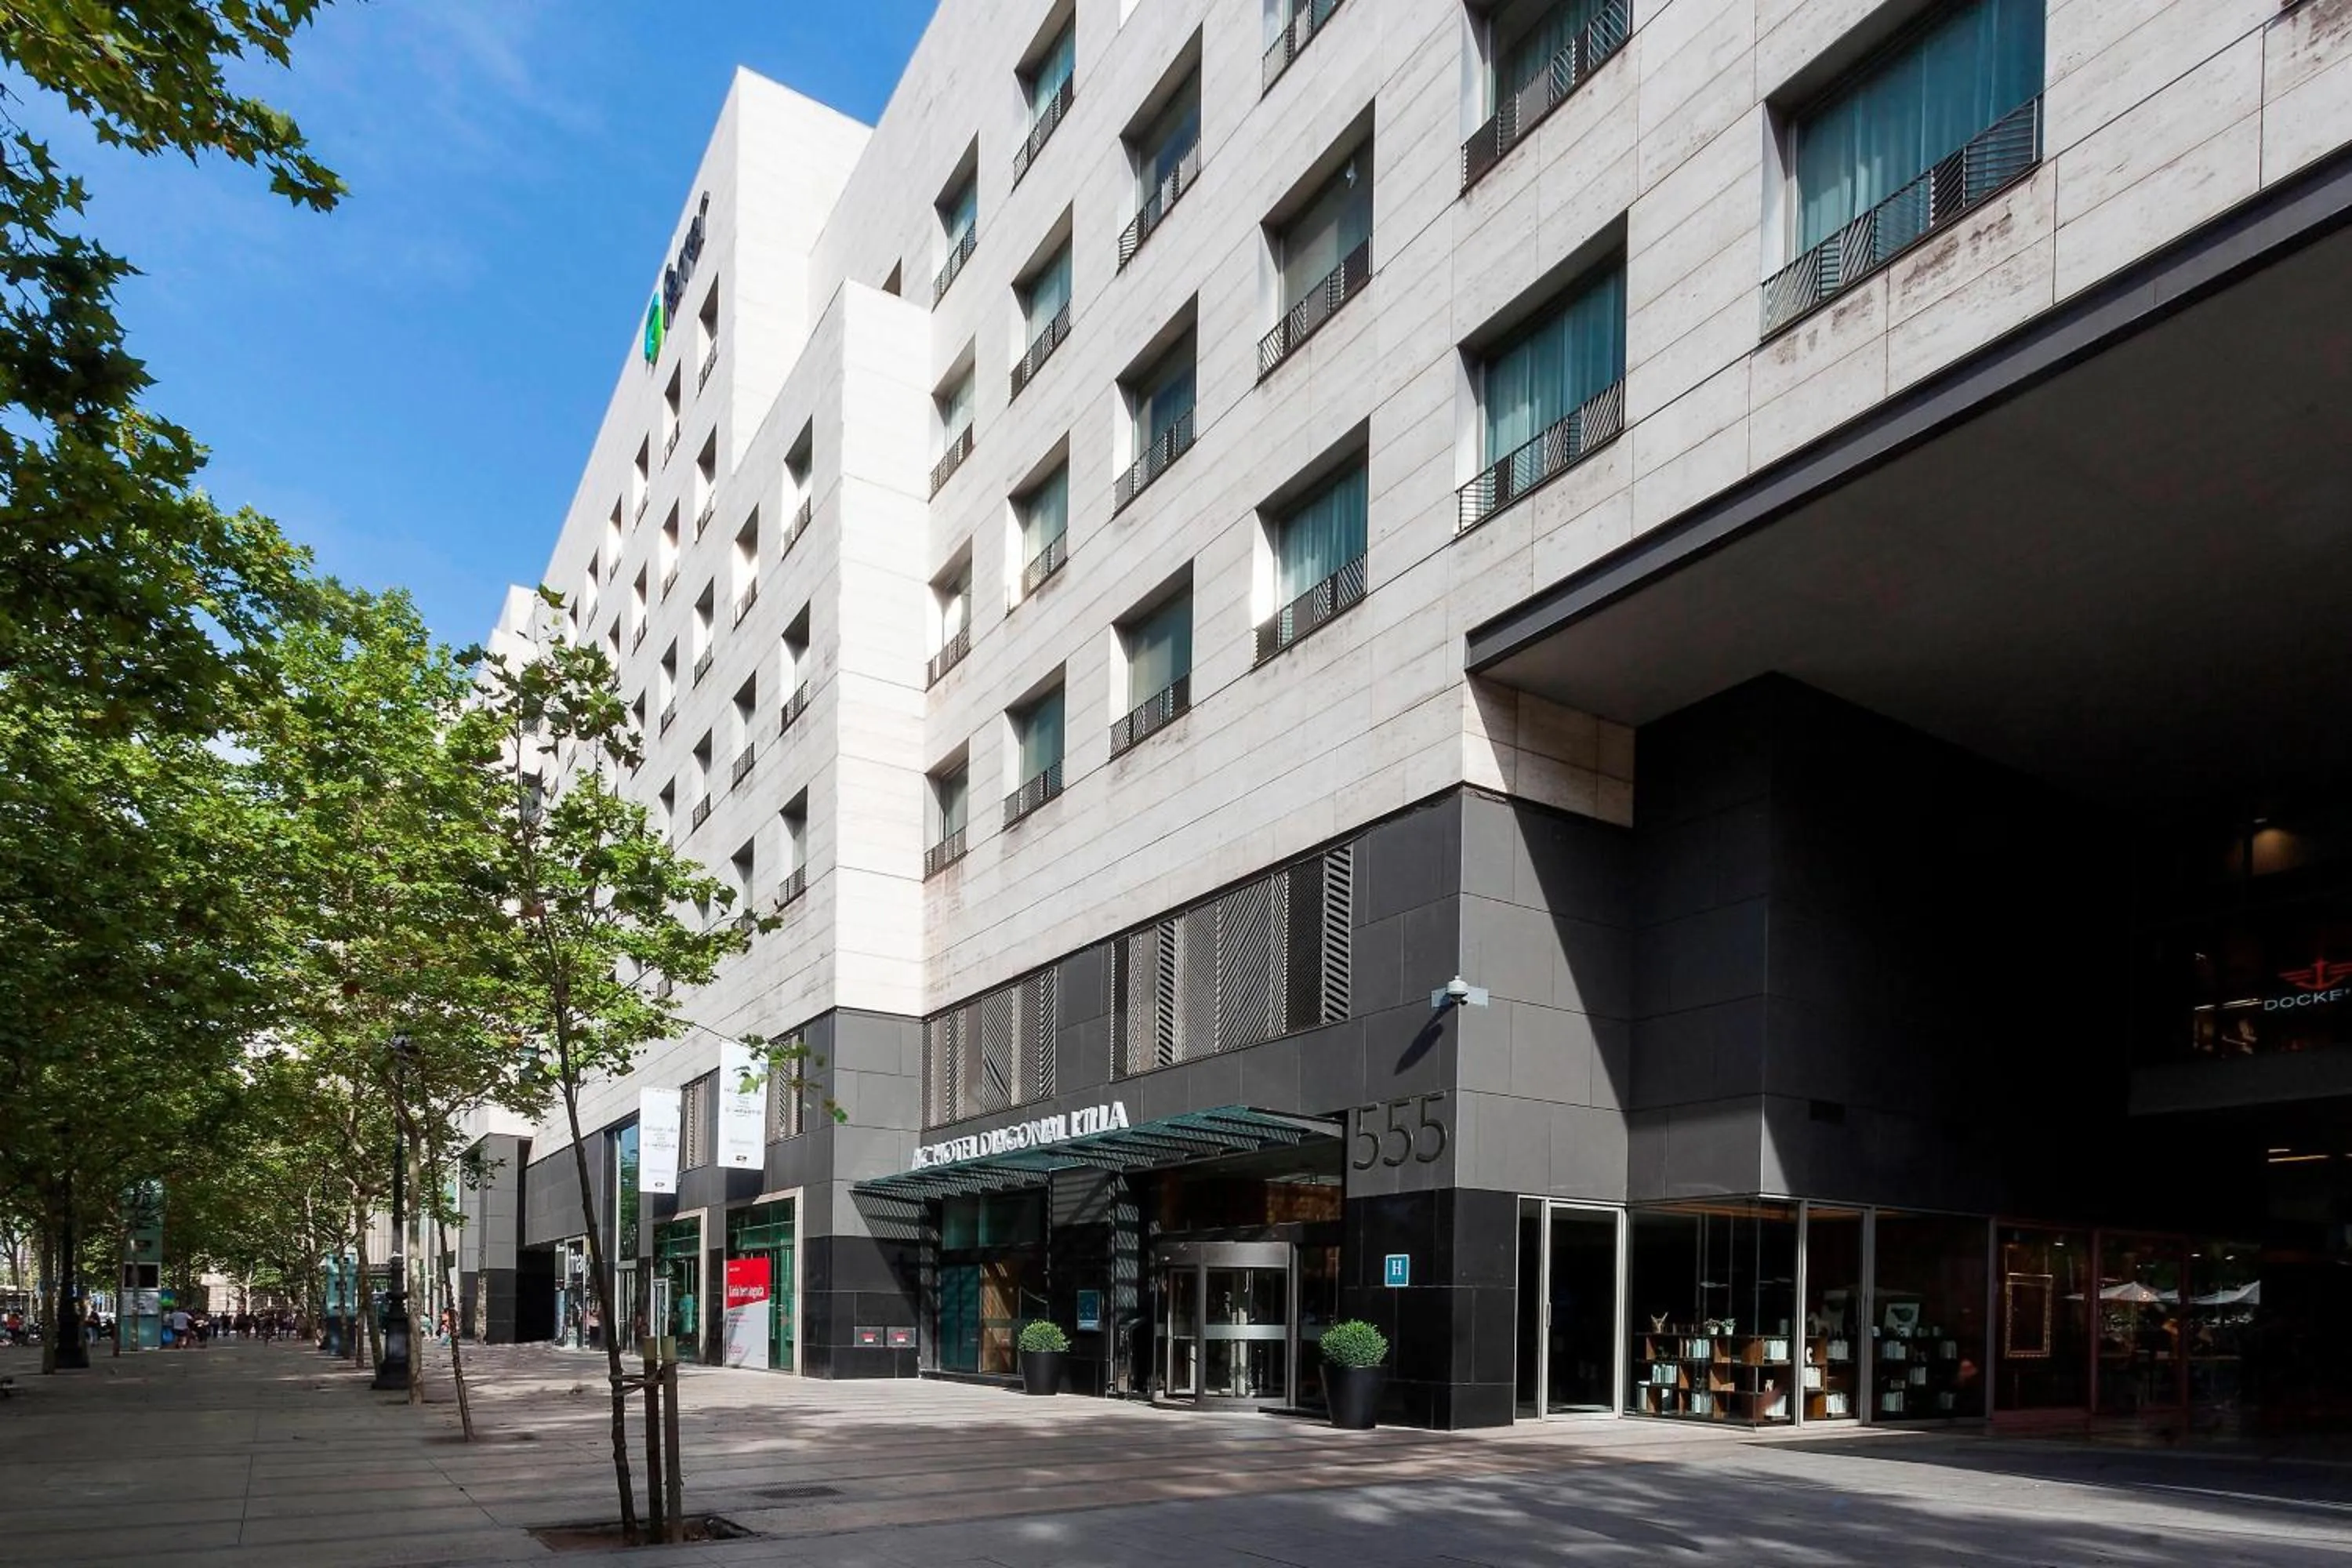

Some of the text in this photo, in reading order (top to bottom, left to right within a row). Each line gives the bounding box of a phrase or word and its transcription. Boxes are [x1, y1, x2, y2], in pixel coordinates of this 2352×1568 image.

[2263, 988, 2352, 1011] DOCKE
[912, 1145, 933, 1171] AC
[933, 1135, 981, 1166] HOTEL
[979, 1114, 1070, 1156] DIAGONAL
[1353, 1091, 1448, 1170] 555
[1392, 1260, 1403, 1276] H
